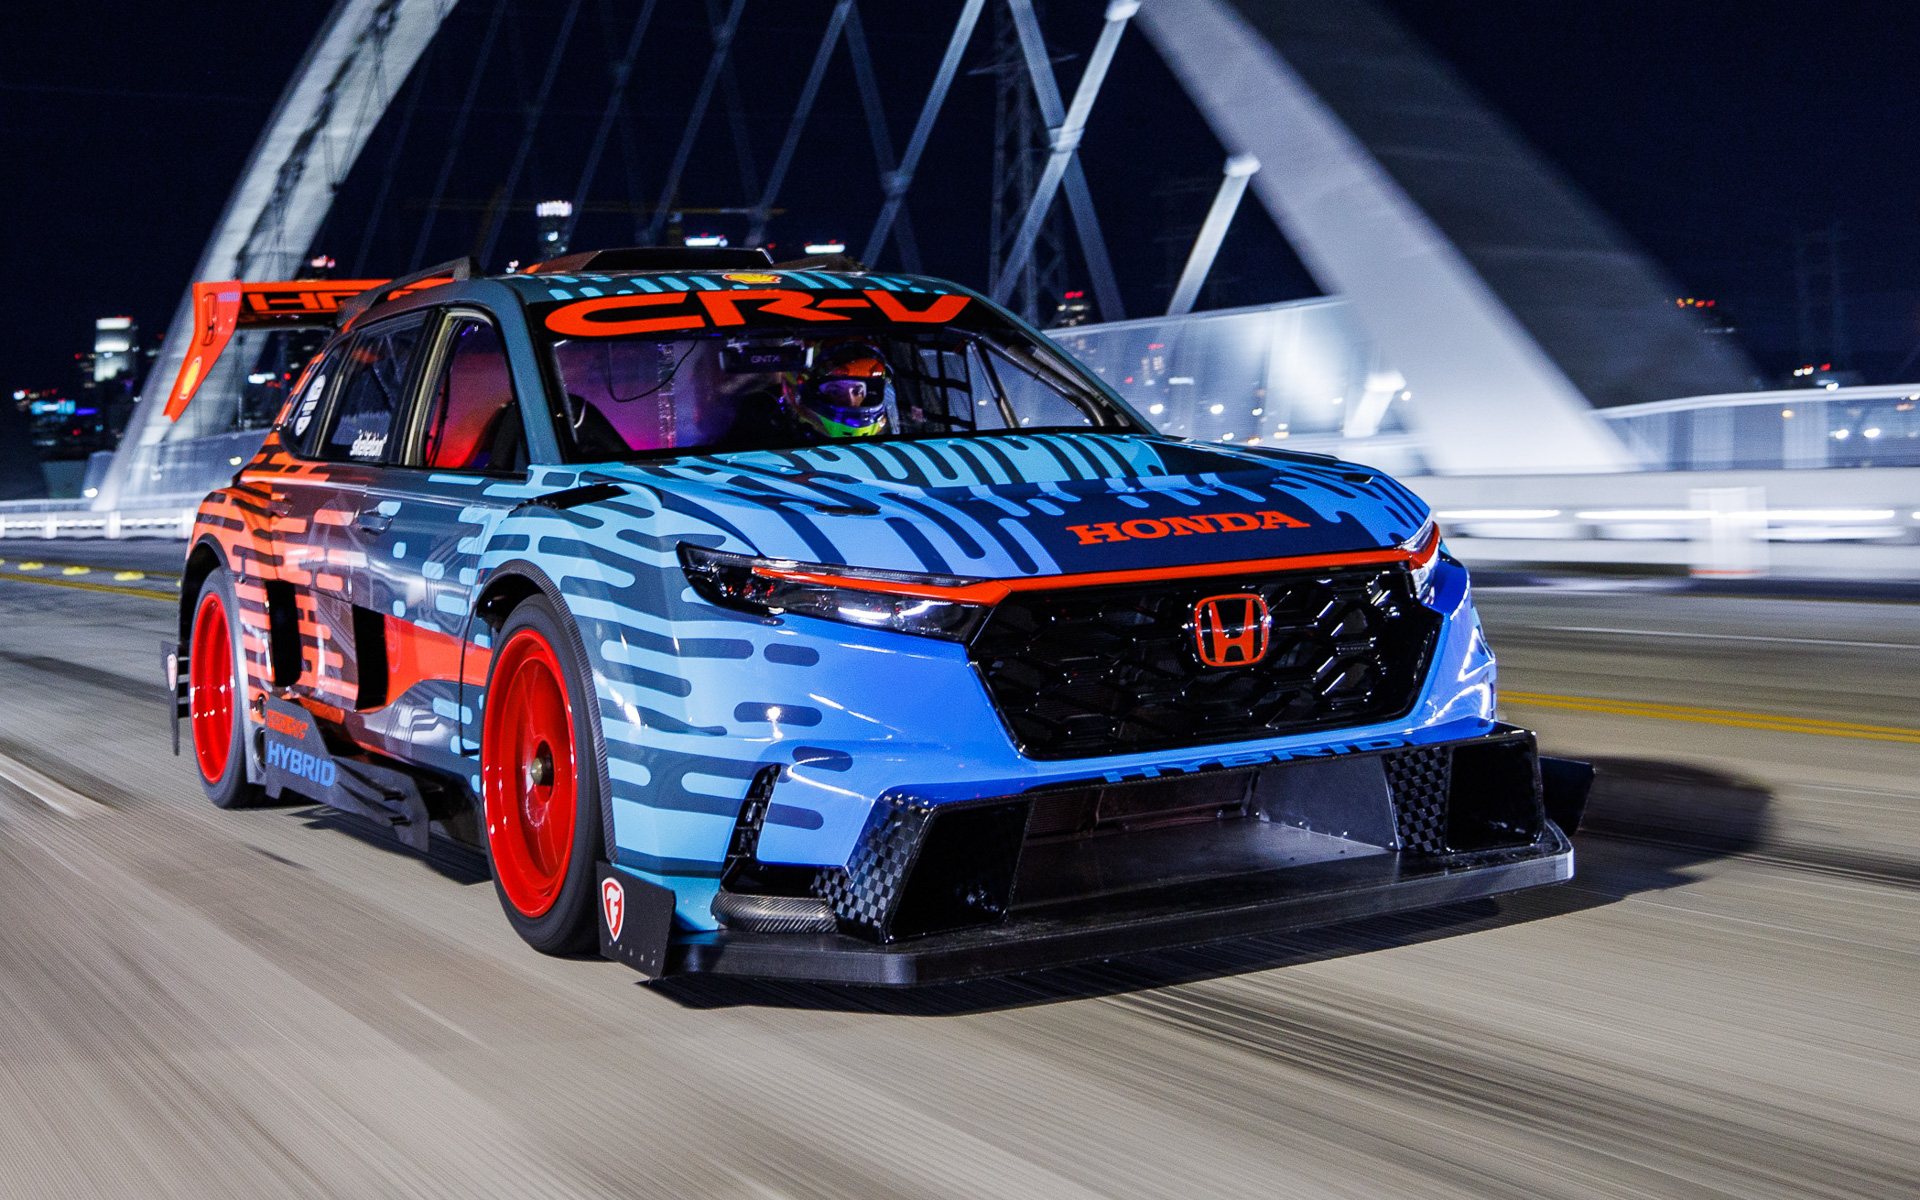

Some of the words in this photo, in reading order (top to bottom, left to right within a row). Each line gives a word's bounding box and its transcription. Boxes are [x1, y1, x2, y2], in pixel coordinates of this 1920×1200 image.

[545, 289, 971, 336] CR-V
[1066, 511, 1311, 545] HONDA
[267, 740, 336, 787] HYBRID
[1103, 737, 1406, 783] HYBRID
